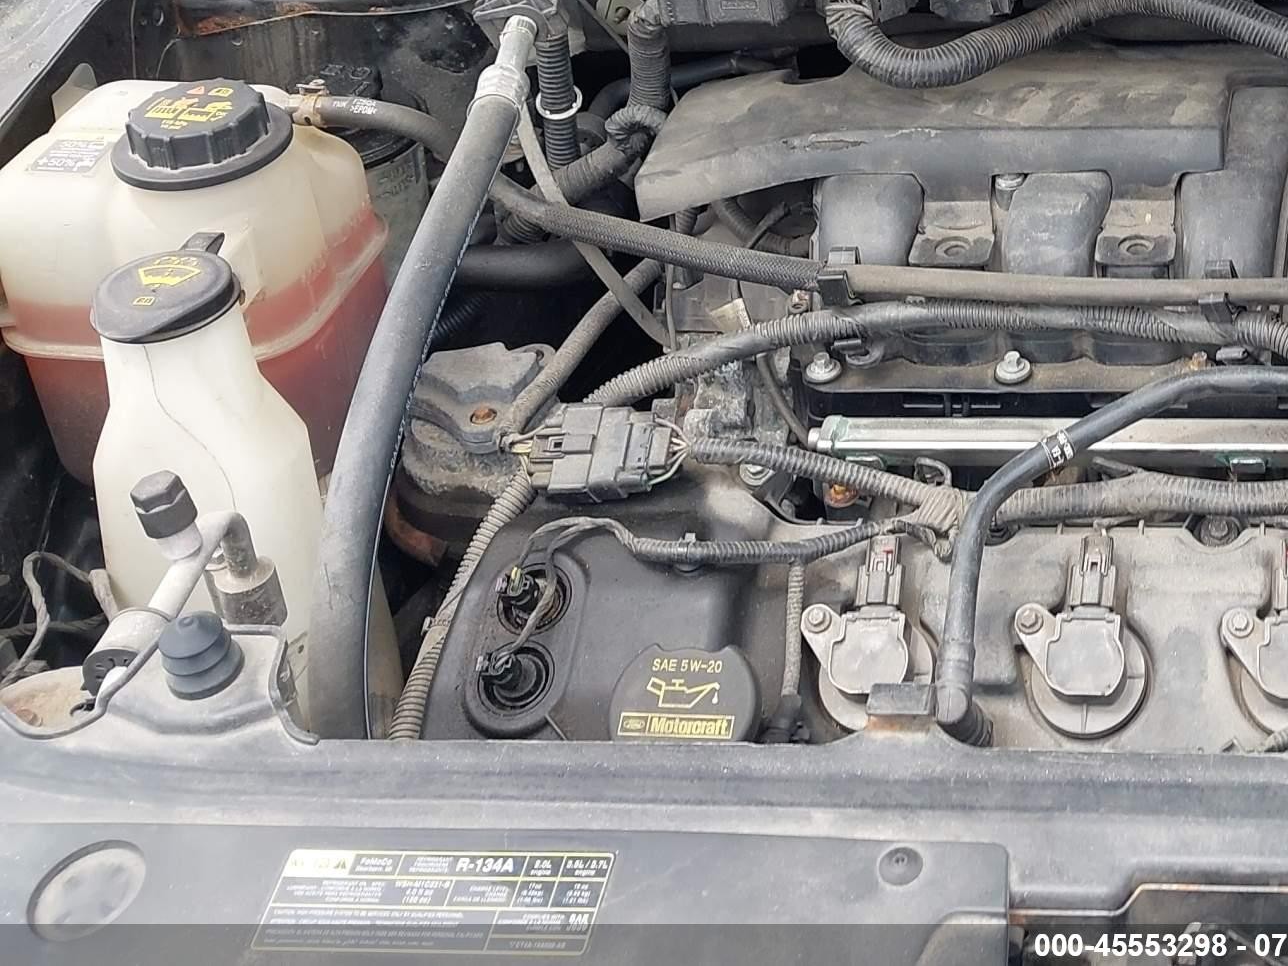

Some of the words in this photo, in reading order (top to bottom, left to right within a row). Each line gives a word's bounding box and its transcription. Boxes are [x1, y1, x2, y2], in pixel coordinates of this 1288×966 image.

[652, 658, 678, 672] SAE
[680, 659, 723, 674] 5W-20
[650, 717, 728, 736] Motorcraft
[455, 857, 515, 874] R-134A
